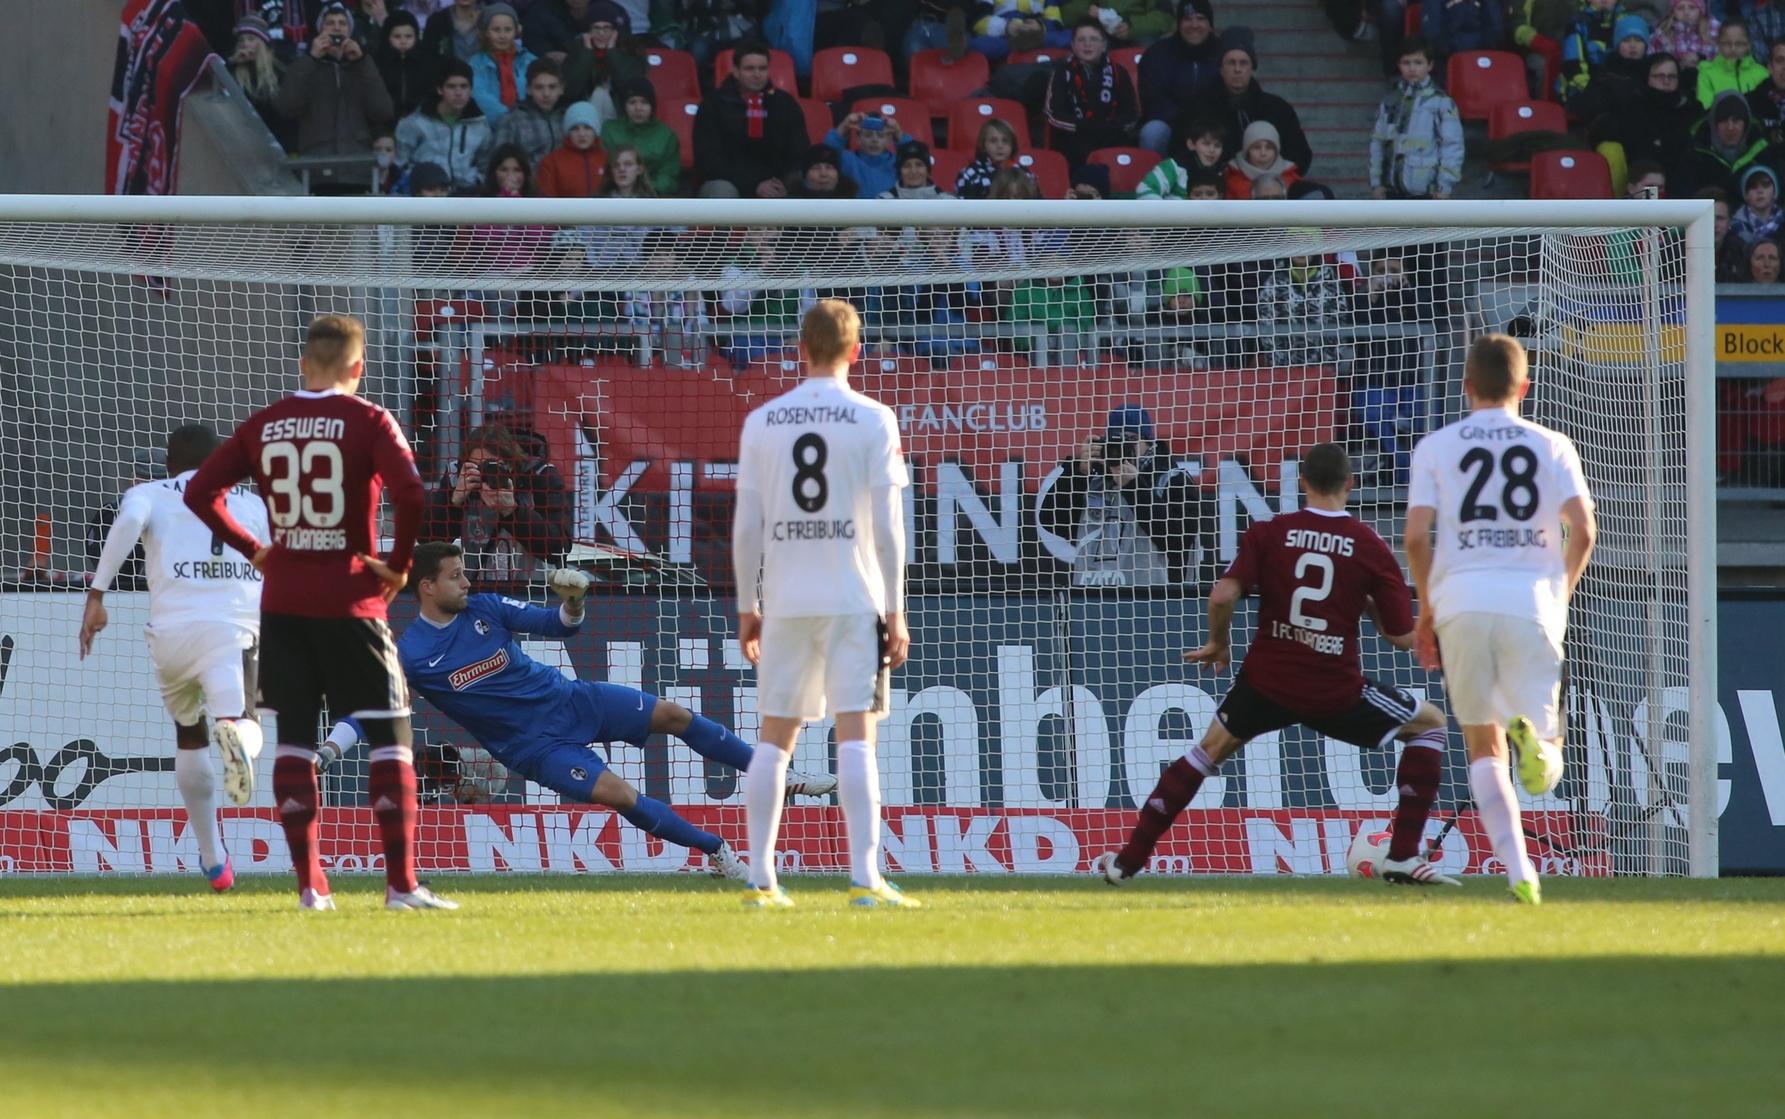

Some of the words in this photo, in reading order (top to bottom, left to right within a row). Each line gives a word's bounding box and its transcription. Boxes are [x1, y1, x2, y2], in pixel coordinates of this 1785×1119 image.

[1725, 332, 1784, 354] Block
[766, 405, 858, 426] ROSENTHAL
[901, 404, 1047, 431] FANCLUB
[261, 417, 345, 442] ESSWEIN
[261, 441, 345, 528] 33
[792, 432, 828, 513] 8
[1459, 445, 1539, 524] 28
[787, 519, 855, 540] FREIBURG
[1285, 529, 1354, 557] SIMONS
[173, 561, 190, 579] SC
[1290, 552, 1334, 632] 2
[453, 654, 505, 687] Ehrmann
